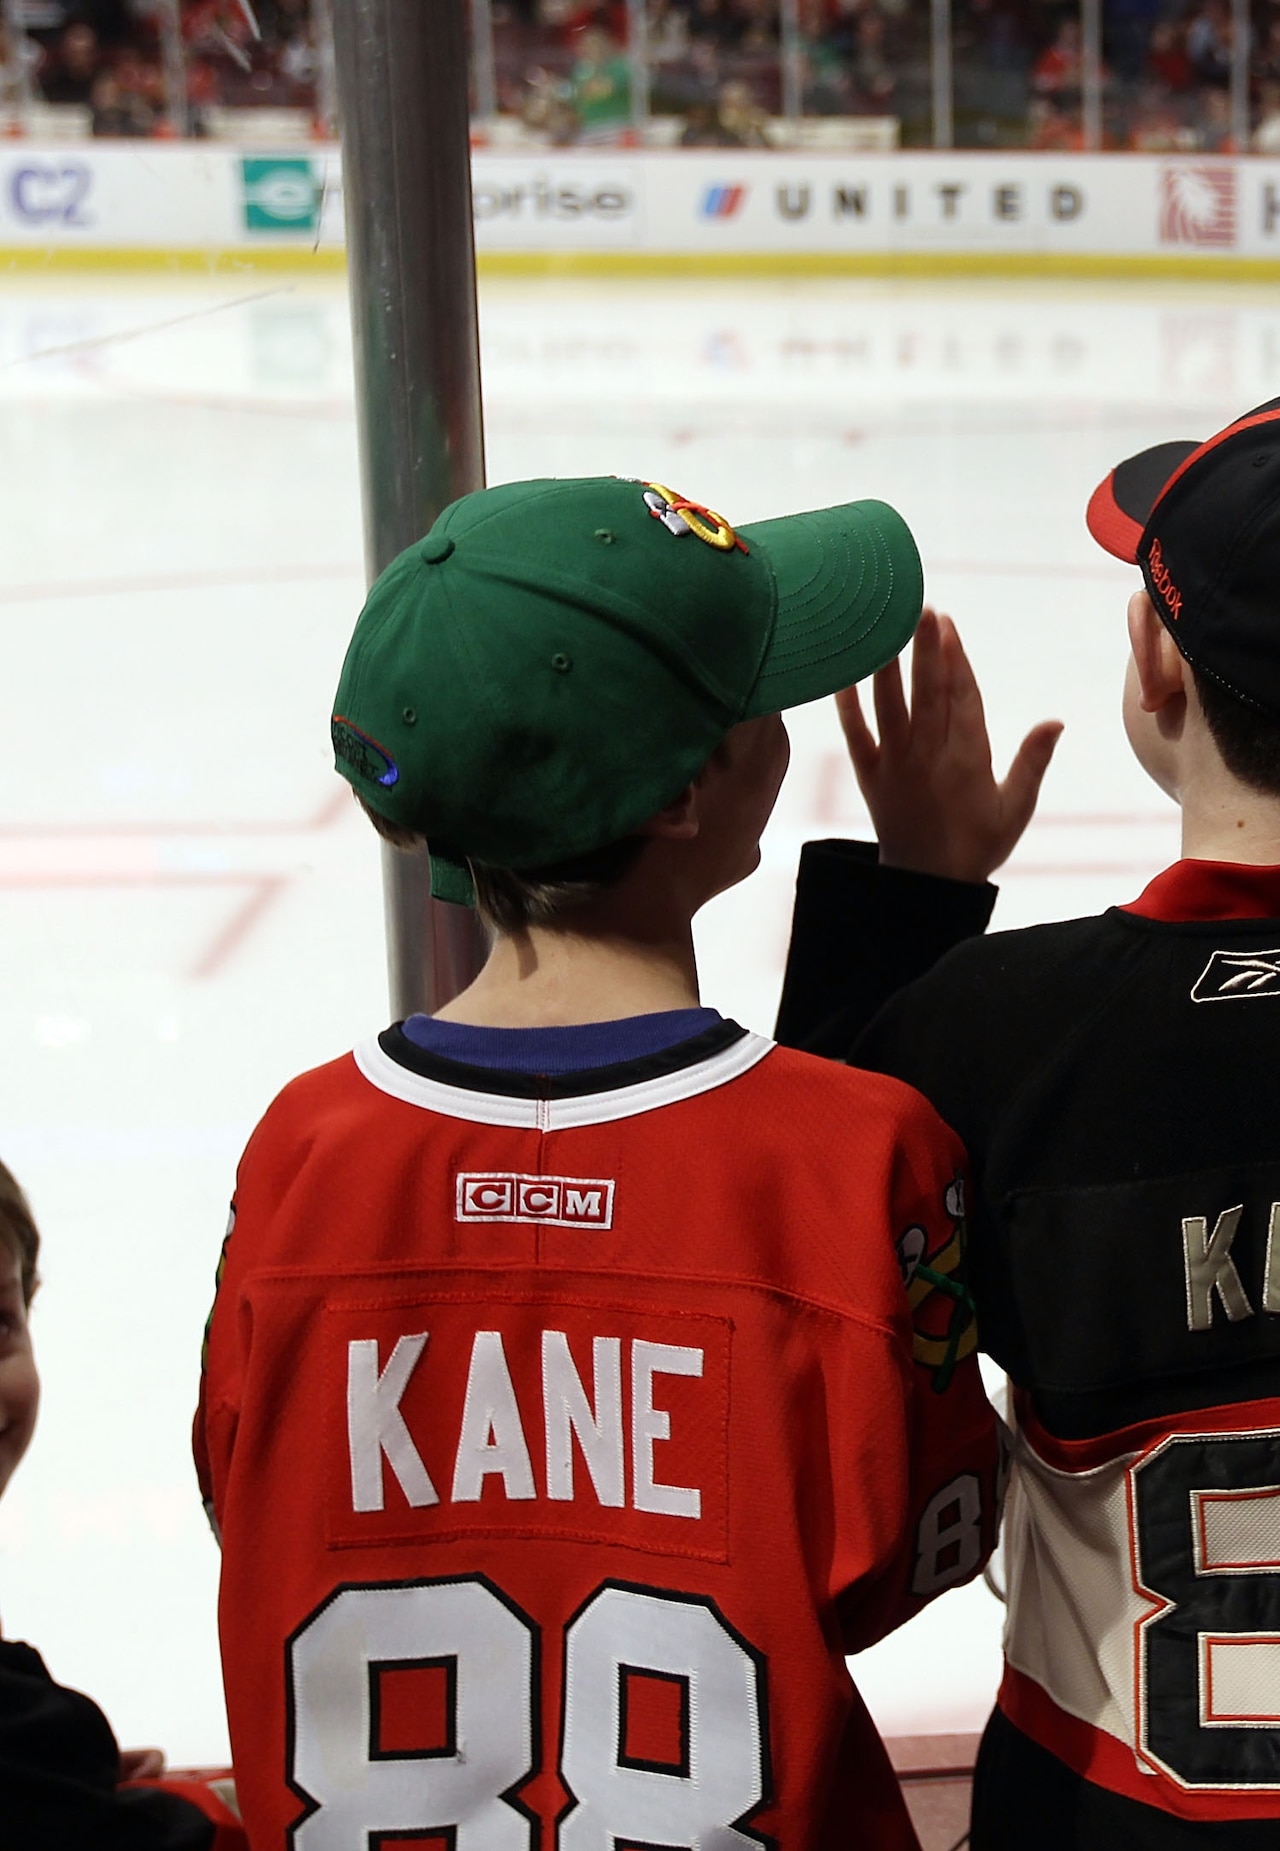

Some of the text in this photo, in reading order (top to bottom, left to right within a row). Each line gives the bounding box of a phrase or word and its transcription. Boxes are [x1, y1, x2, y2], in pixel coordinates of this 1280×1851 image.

[774, 180, 1086, 222] UNITED
[464, 1178, 608, 1222] CCM
[346, 1331, 704, 1519] KANE
[286, 1572, 769, 1851] 88
